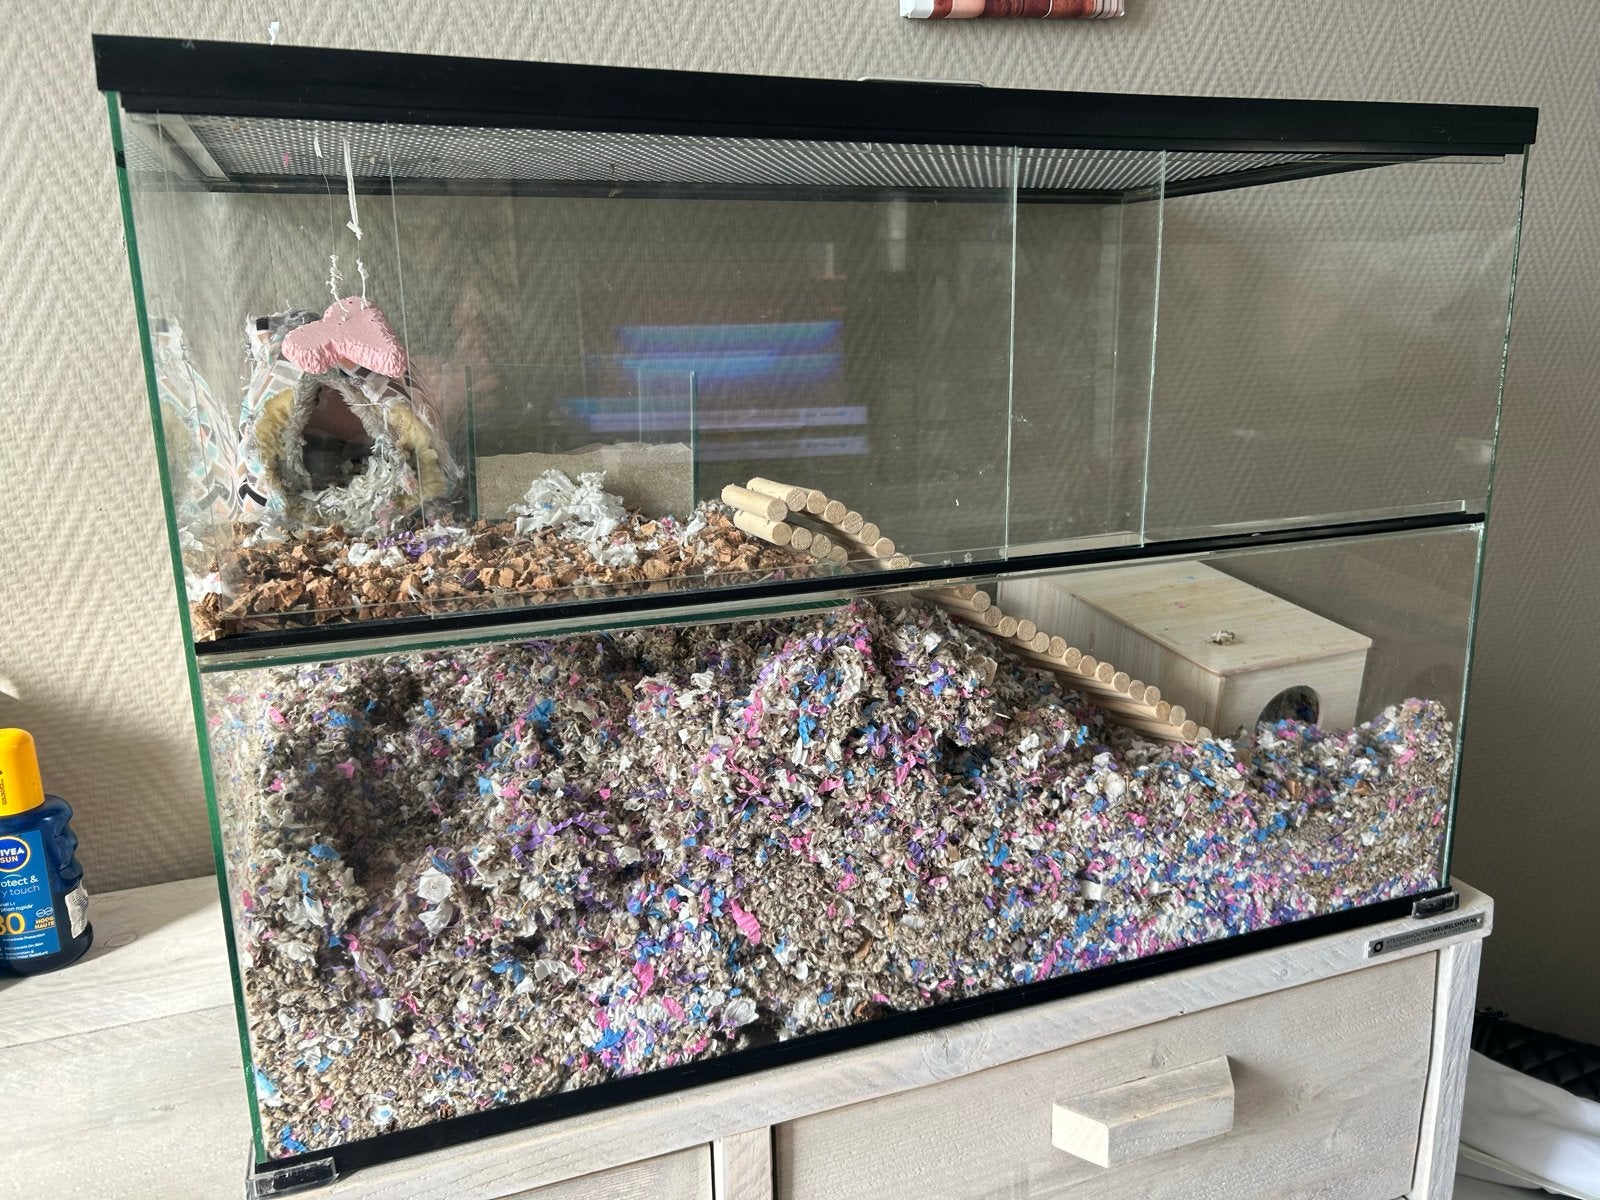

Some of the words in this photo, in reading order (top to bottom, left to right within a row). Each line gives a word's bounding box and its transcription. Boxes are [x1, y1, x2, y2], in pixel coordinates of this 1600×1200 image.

[0, 847, 25, 857] IVEA
[0, 856, 19, 864] SUN
[0, 877, 29, 888] otect
[30, 875, 38, 883] &
[9, 885, 40, 896] touch
